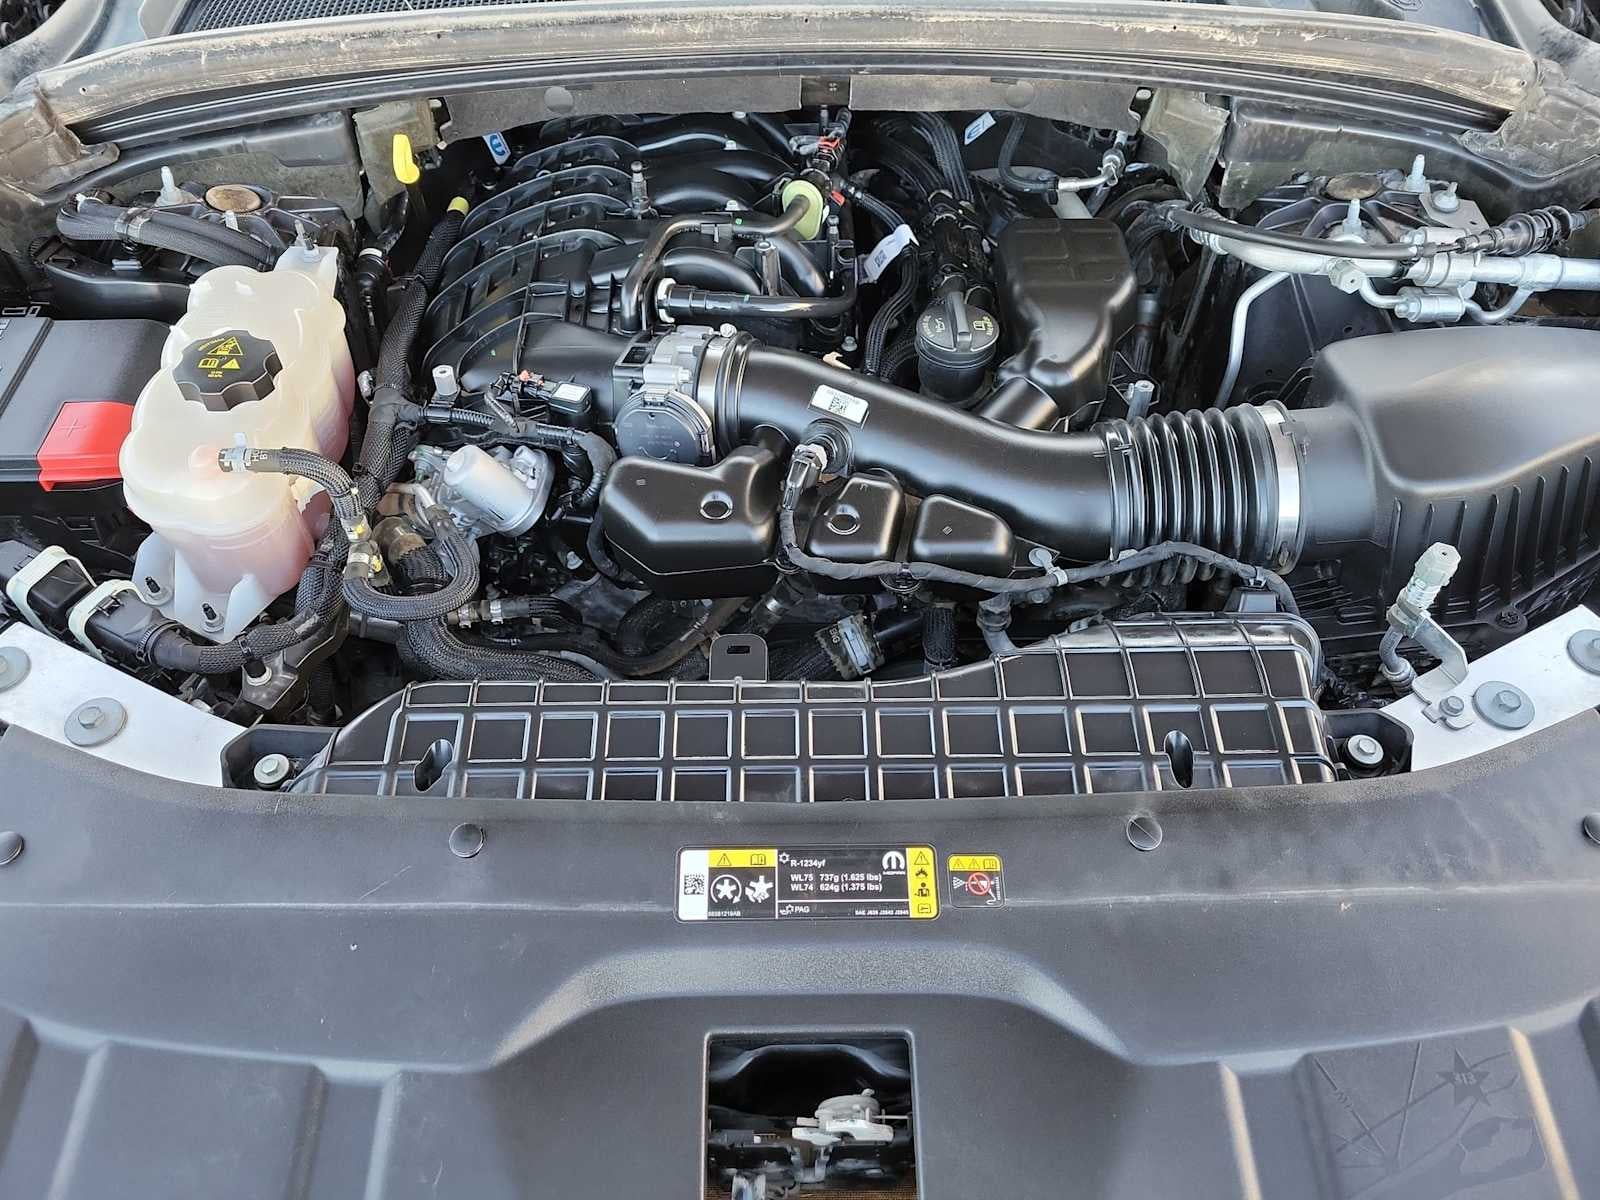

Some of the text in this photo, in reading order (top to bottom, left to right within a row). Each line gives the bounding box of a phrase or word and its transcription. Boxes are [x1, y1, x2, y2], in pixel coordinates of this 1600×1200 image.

[790, 858, 826, 868] R-1234yf
[790, 873, 882, 883] WL75 737g (1.625 lbs)
[790, 882, 883, 893] WL74 624g (1.375 lbs)
